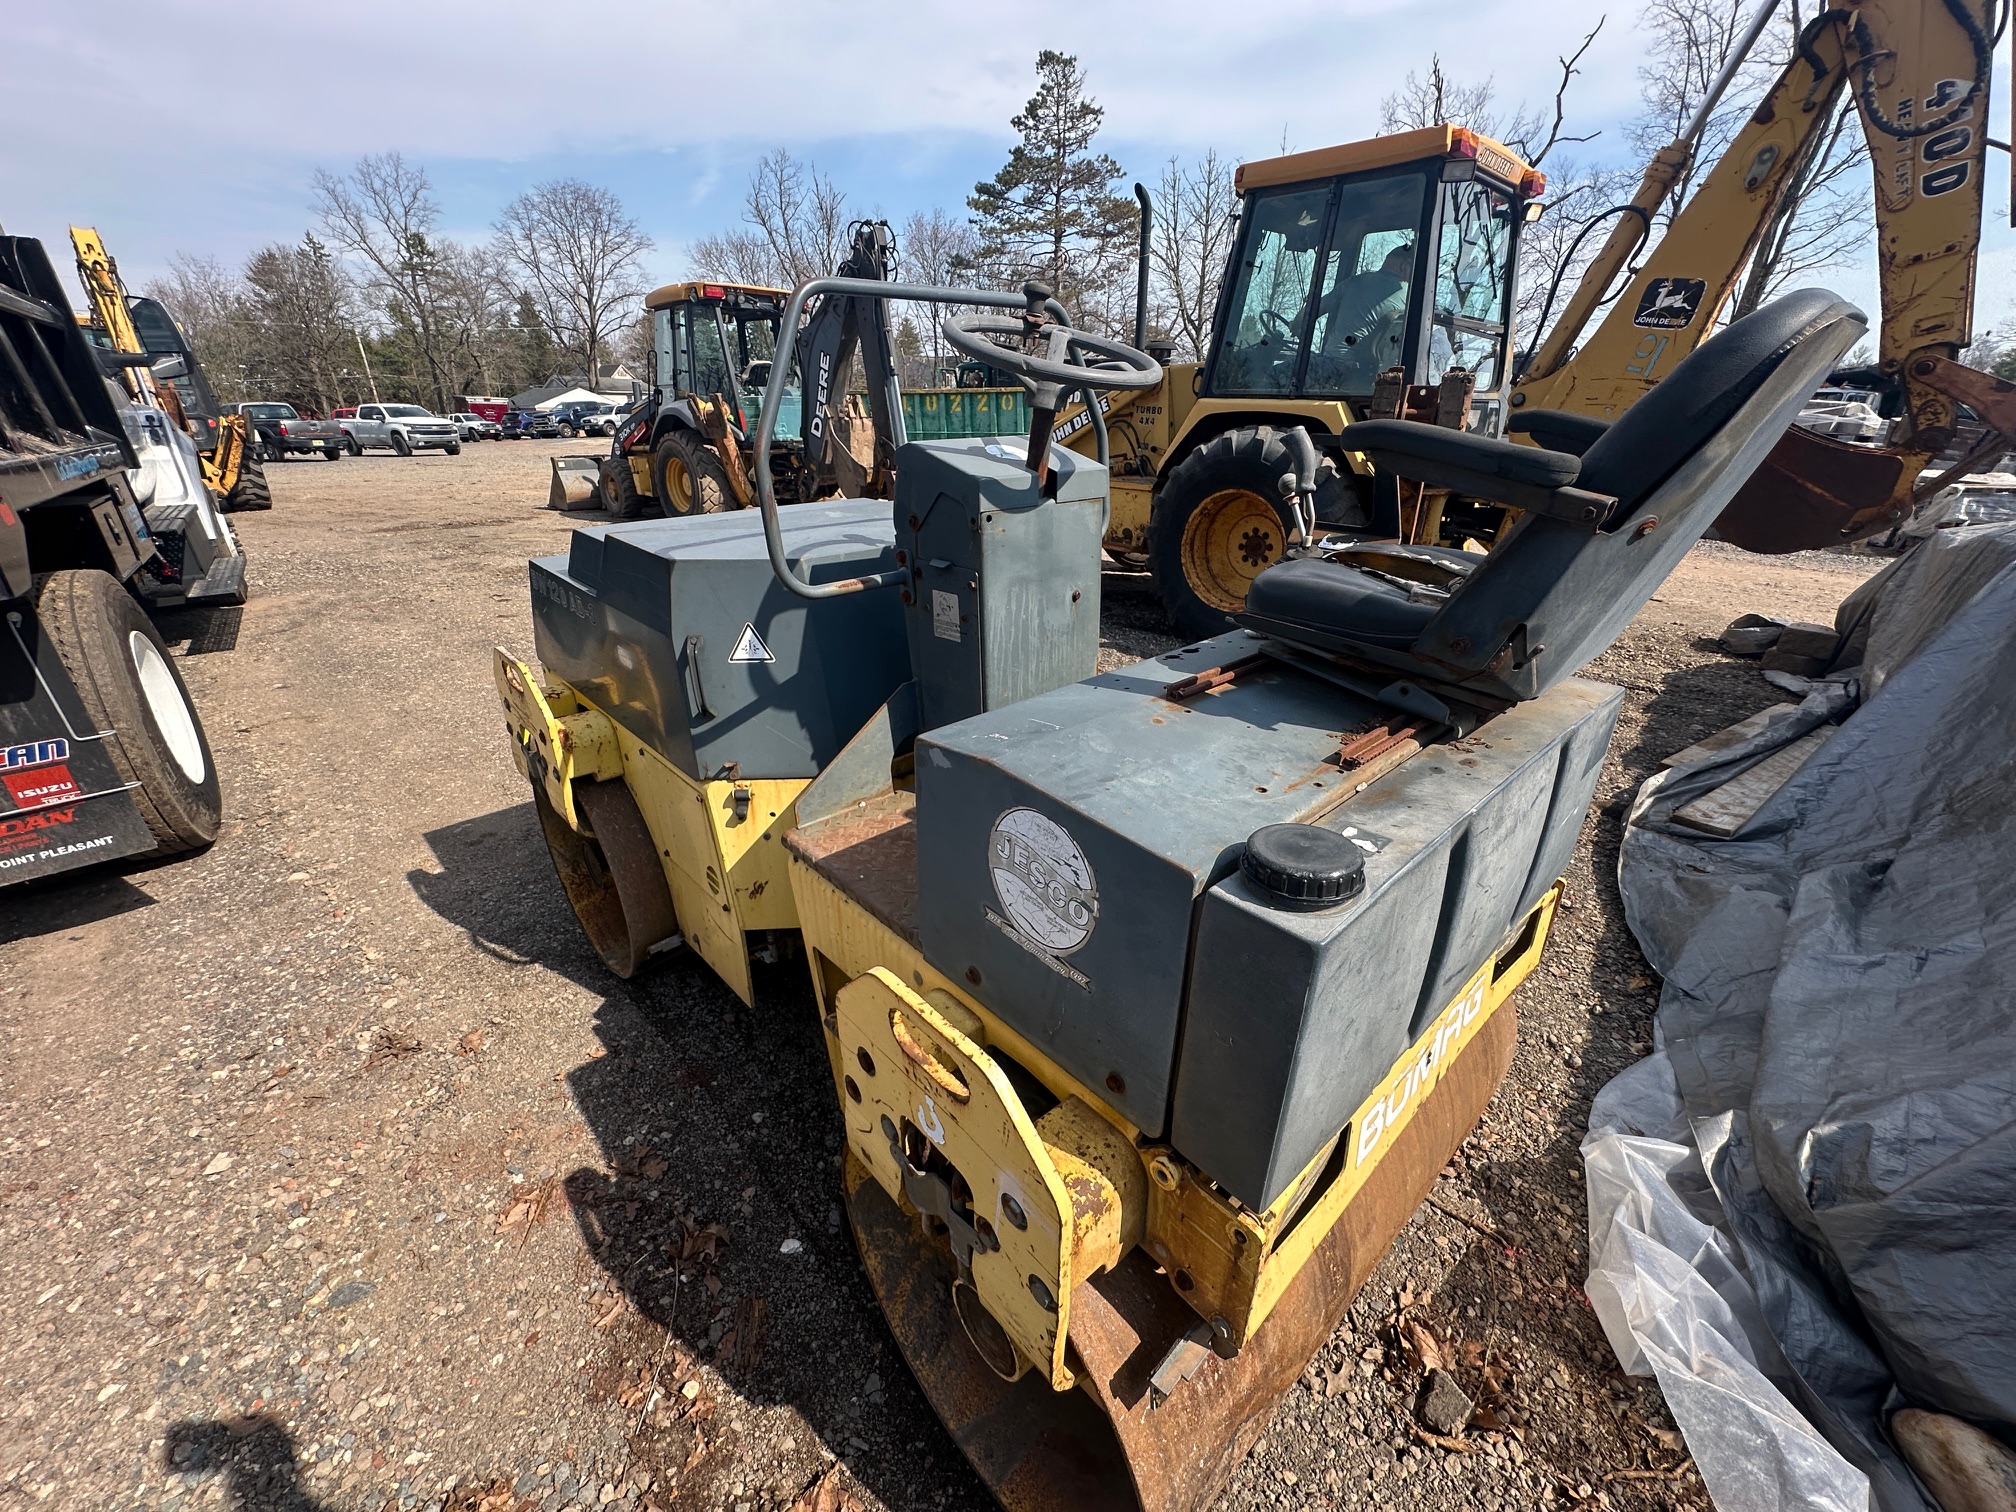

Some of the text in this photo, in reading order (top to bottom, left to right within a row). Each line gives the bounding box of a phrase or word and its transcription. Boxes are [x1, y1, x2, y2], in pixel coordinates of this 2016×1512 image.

[1478, 146, 1515, 178] JOHN DEERE
[1635, 316, 1687, 326] JOHN DEE
[810, 351, 831, 439] DEERE
[1135, 405, 1163, 415] TURBO
[1073, 397, 1110, 430] DEE
[16, 781, 73, 799] ISUZU
[40, 835, 114, 859] PLEASANT
[996, 835, 1090, 927] JESCO
[1355, 972, 1488, 1169] BOMAG
